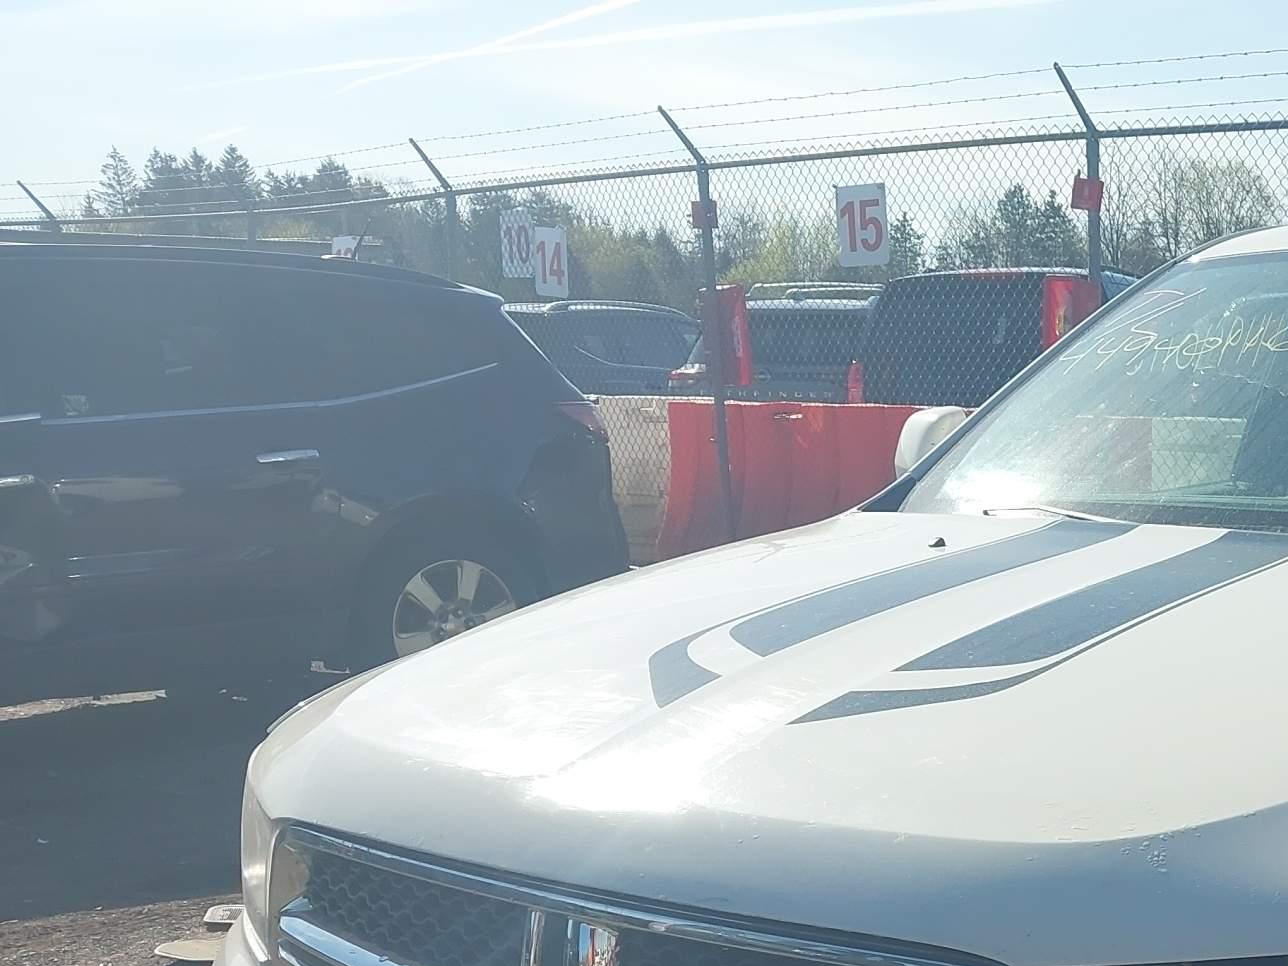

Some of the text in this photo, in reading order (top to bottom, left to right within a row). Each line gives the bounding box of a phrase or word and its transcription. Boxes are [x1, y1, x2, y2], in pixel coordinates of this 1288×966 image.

[504, 224, 530, 264] 10
[840, 198, 883, 252] 15
[536, 240, 565, 286] 14
